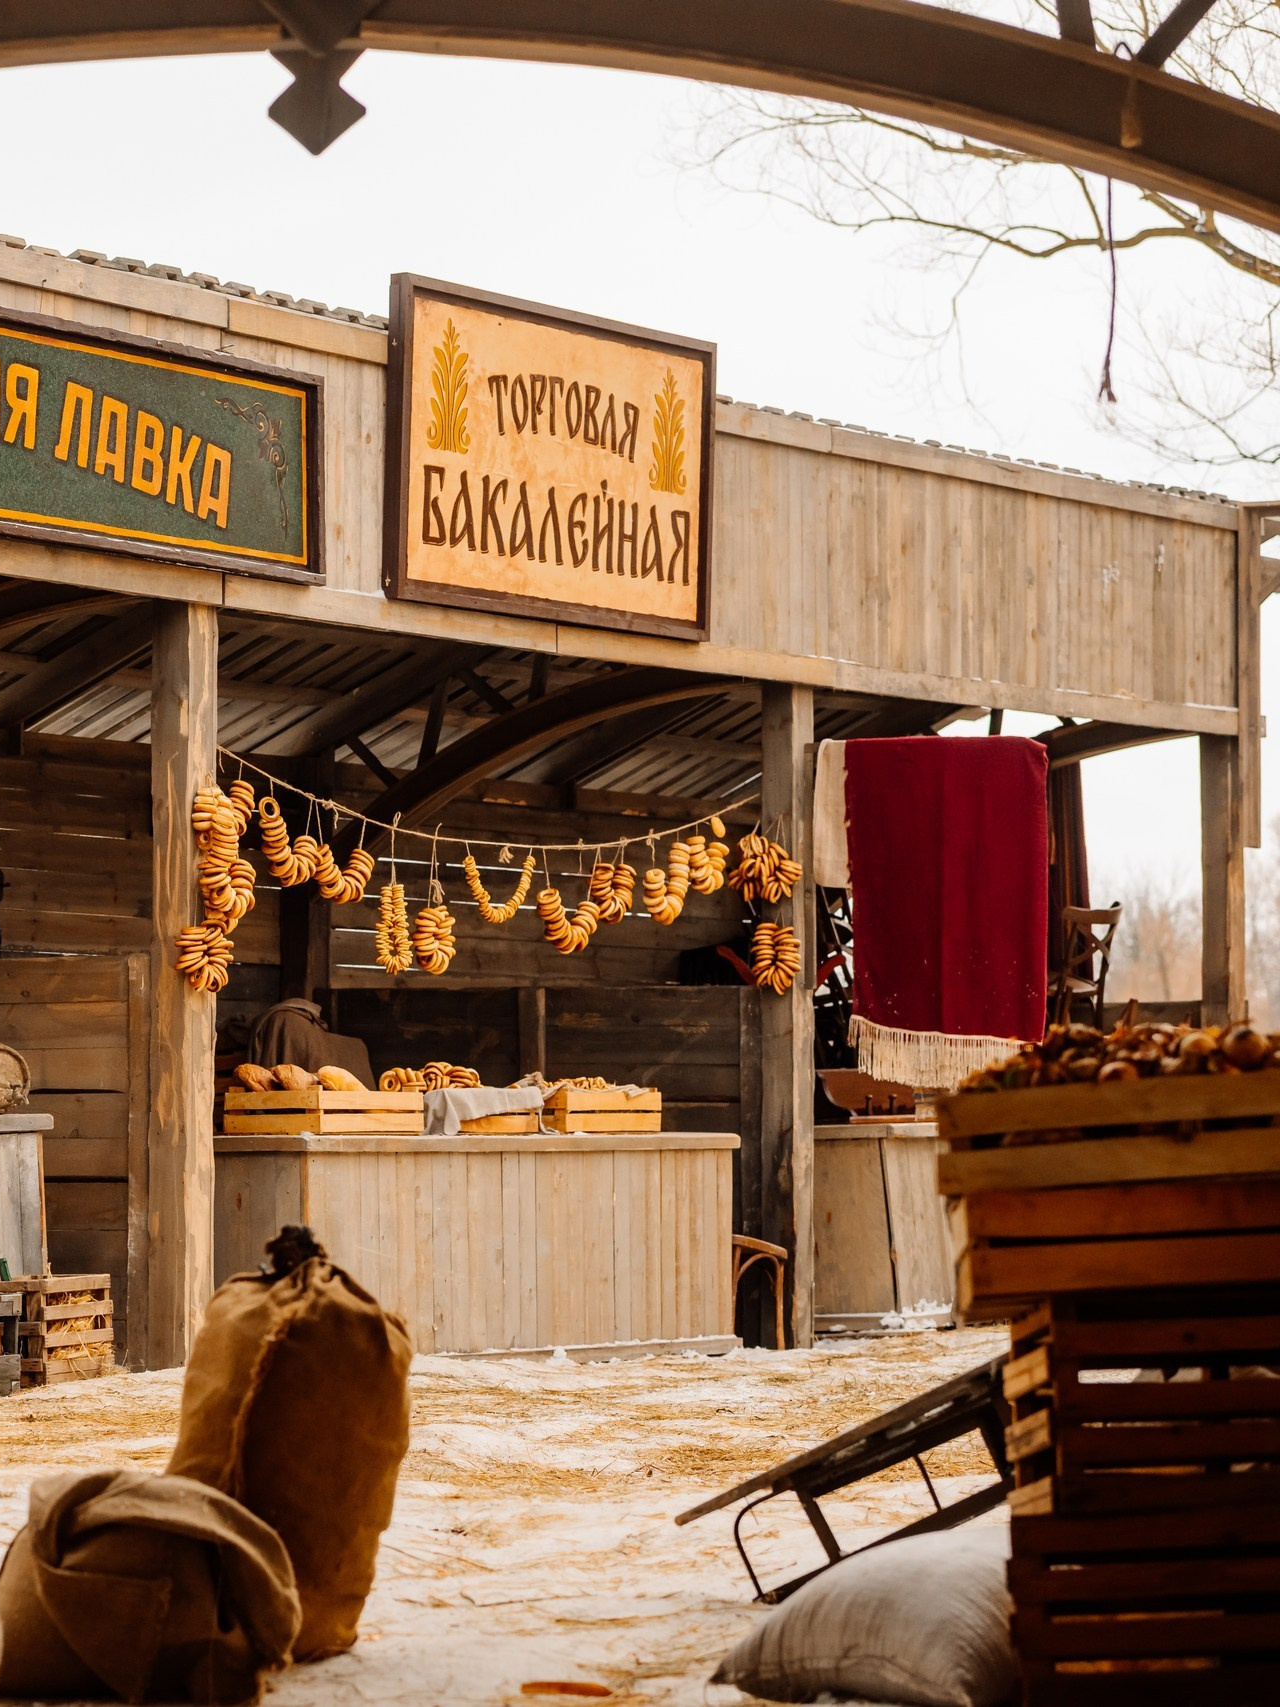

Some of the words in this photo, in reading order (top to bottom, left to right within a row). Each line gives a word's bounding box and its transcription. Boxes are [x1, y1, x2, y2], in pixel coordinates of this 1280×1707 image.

[53, 381, 231, 529] ЛАВКА
[487, 373, 640, 463] ТОРГОВЛЯ
[421, 464, 691, 587] БАКАЛЕЙНАЯ
